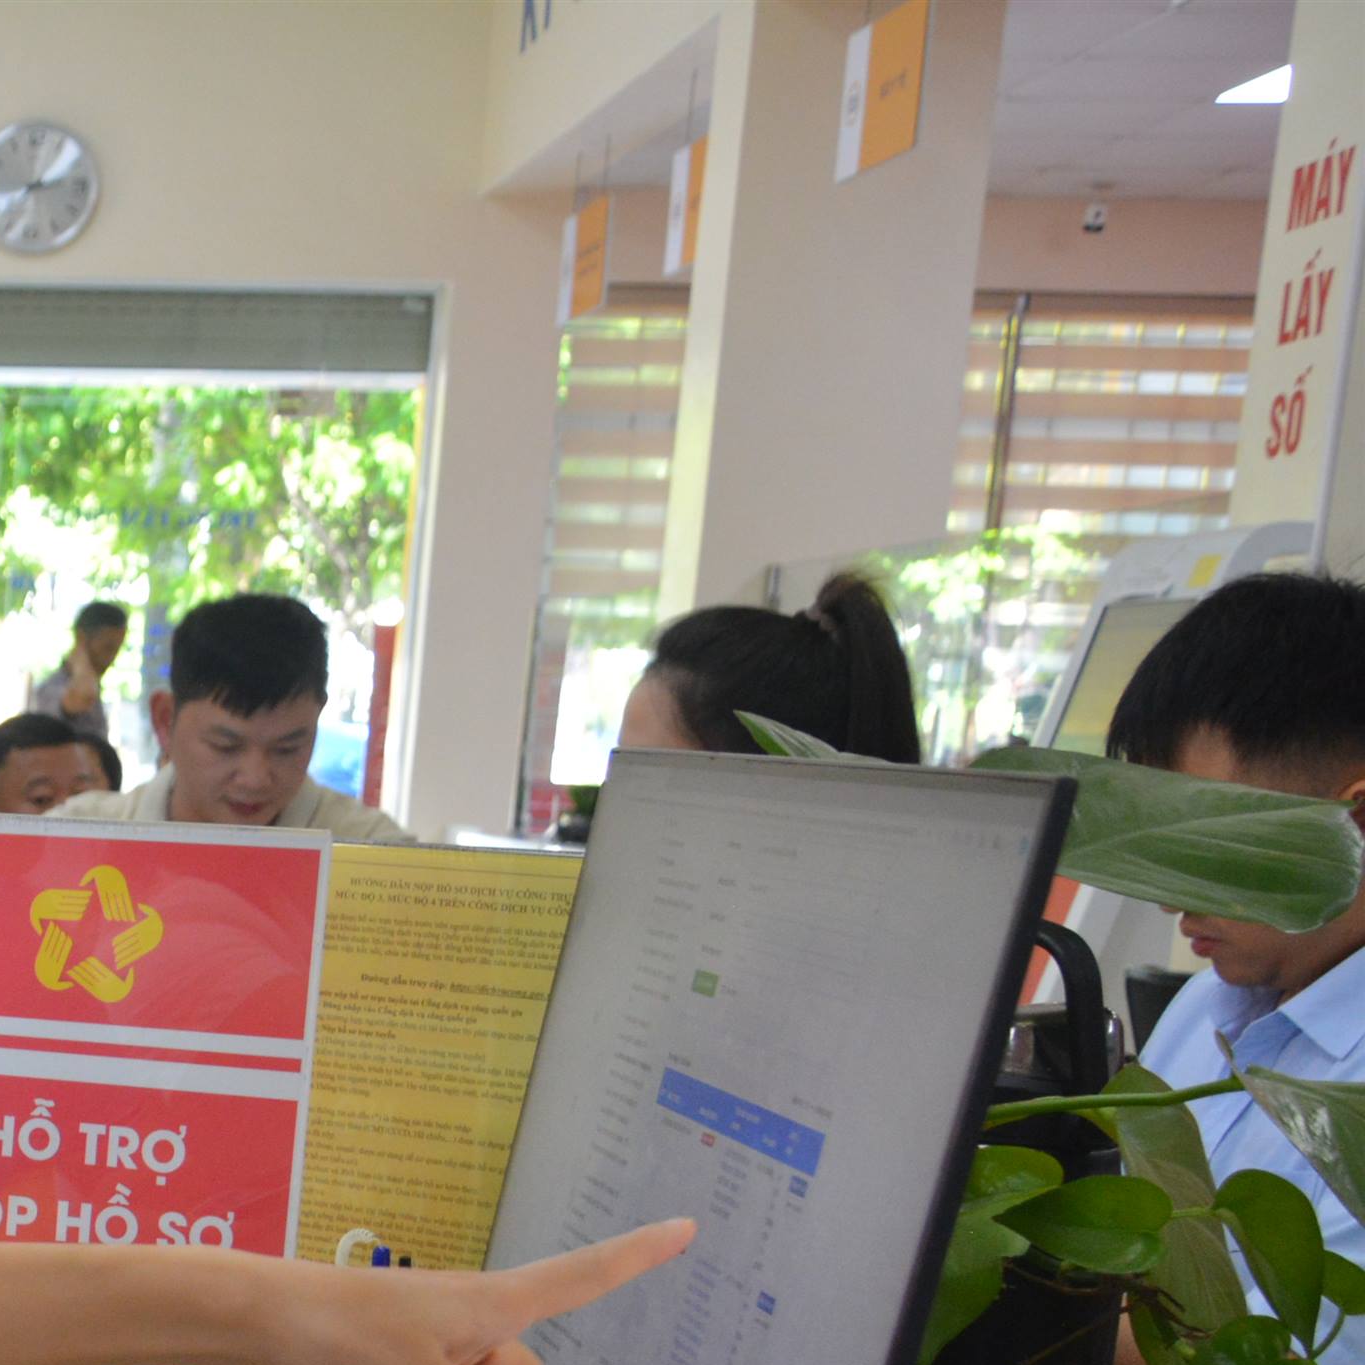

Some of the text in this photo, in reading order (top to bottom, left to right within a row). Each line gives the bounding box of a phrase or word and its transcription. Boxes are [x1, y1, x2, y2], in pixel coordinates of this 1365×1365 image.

[1286, 137, 1356, 232] MÁY
[1277, 247, 1335, 345] LẤY
[1265, 364, 1313, 460] SỐ
[79, 1123, 187, 1186] TRỢ
[55, 1183, 138, 1245] HỒ
[156, 1211, 235, 1249] SƠ
